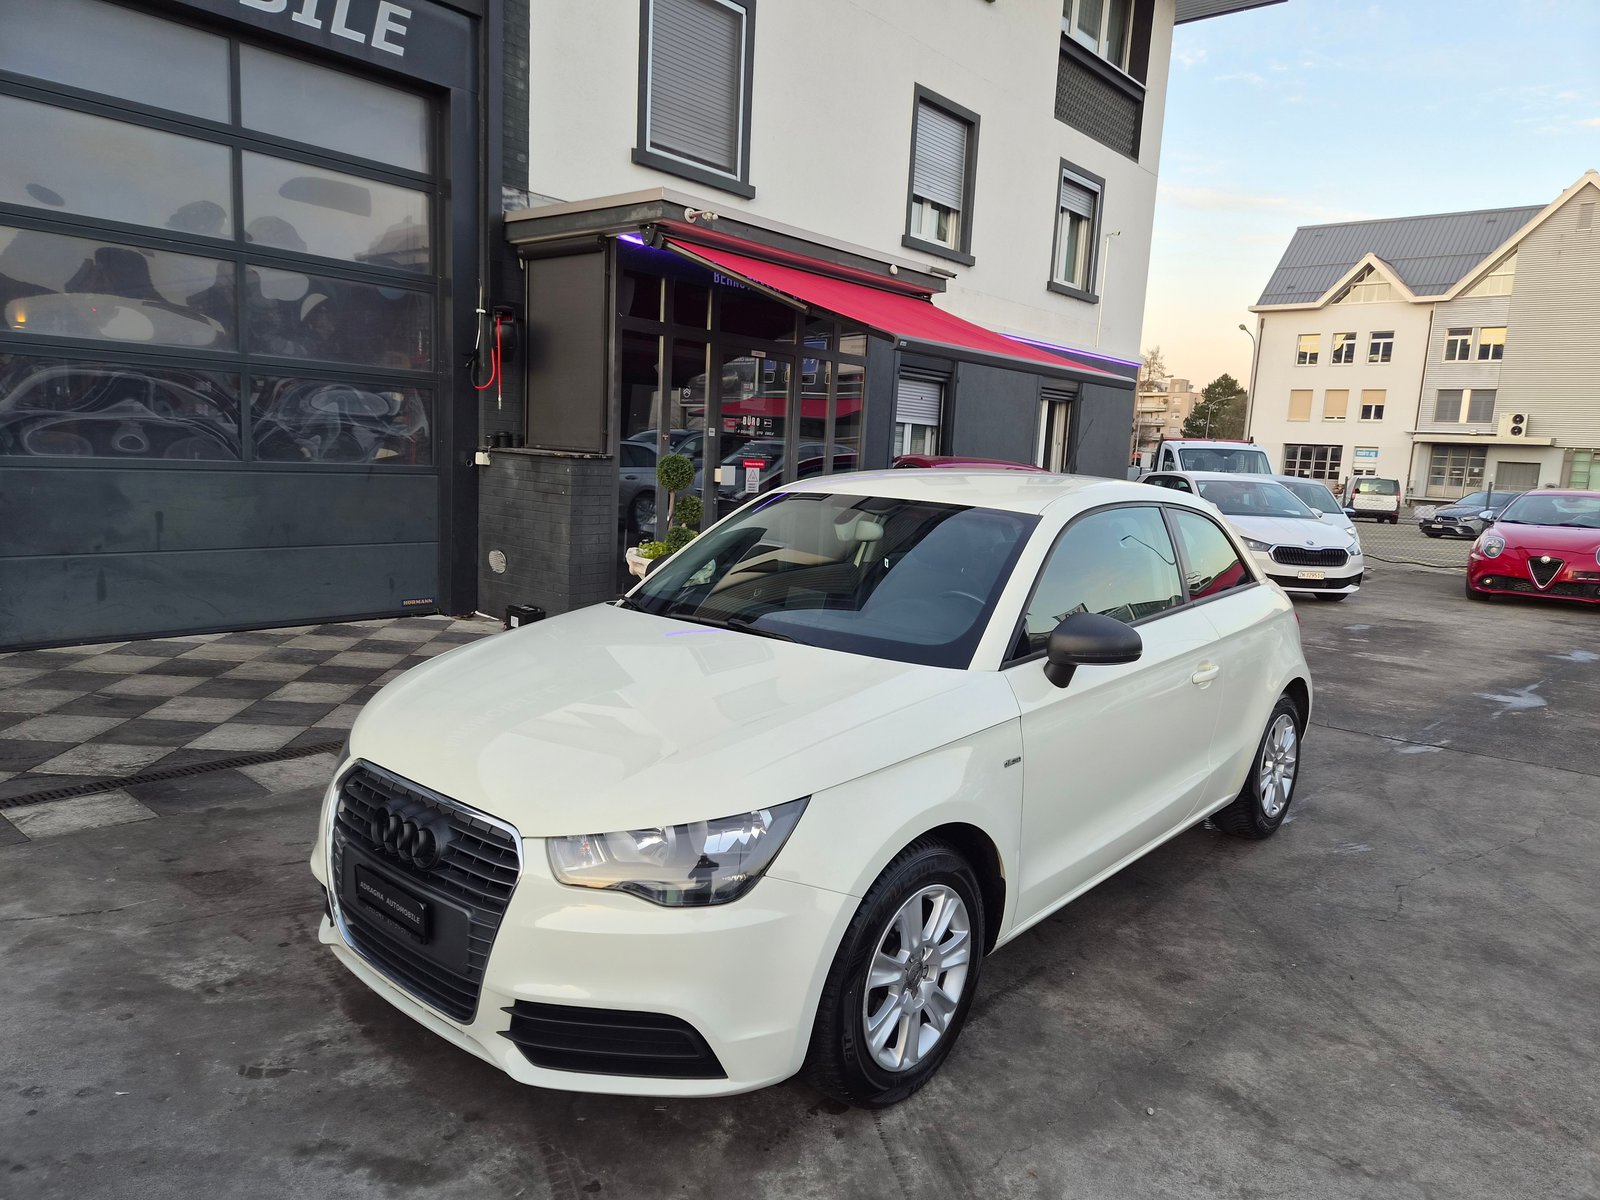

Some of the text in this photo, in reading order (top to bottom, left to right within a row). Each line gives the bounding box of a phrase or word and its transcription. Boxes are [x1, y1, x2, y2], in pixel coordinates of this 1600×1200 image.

[239, 0, 412, 57] ILE
[360, 881, 421, 925] ADRAGNA AUTOMOBILE
